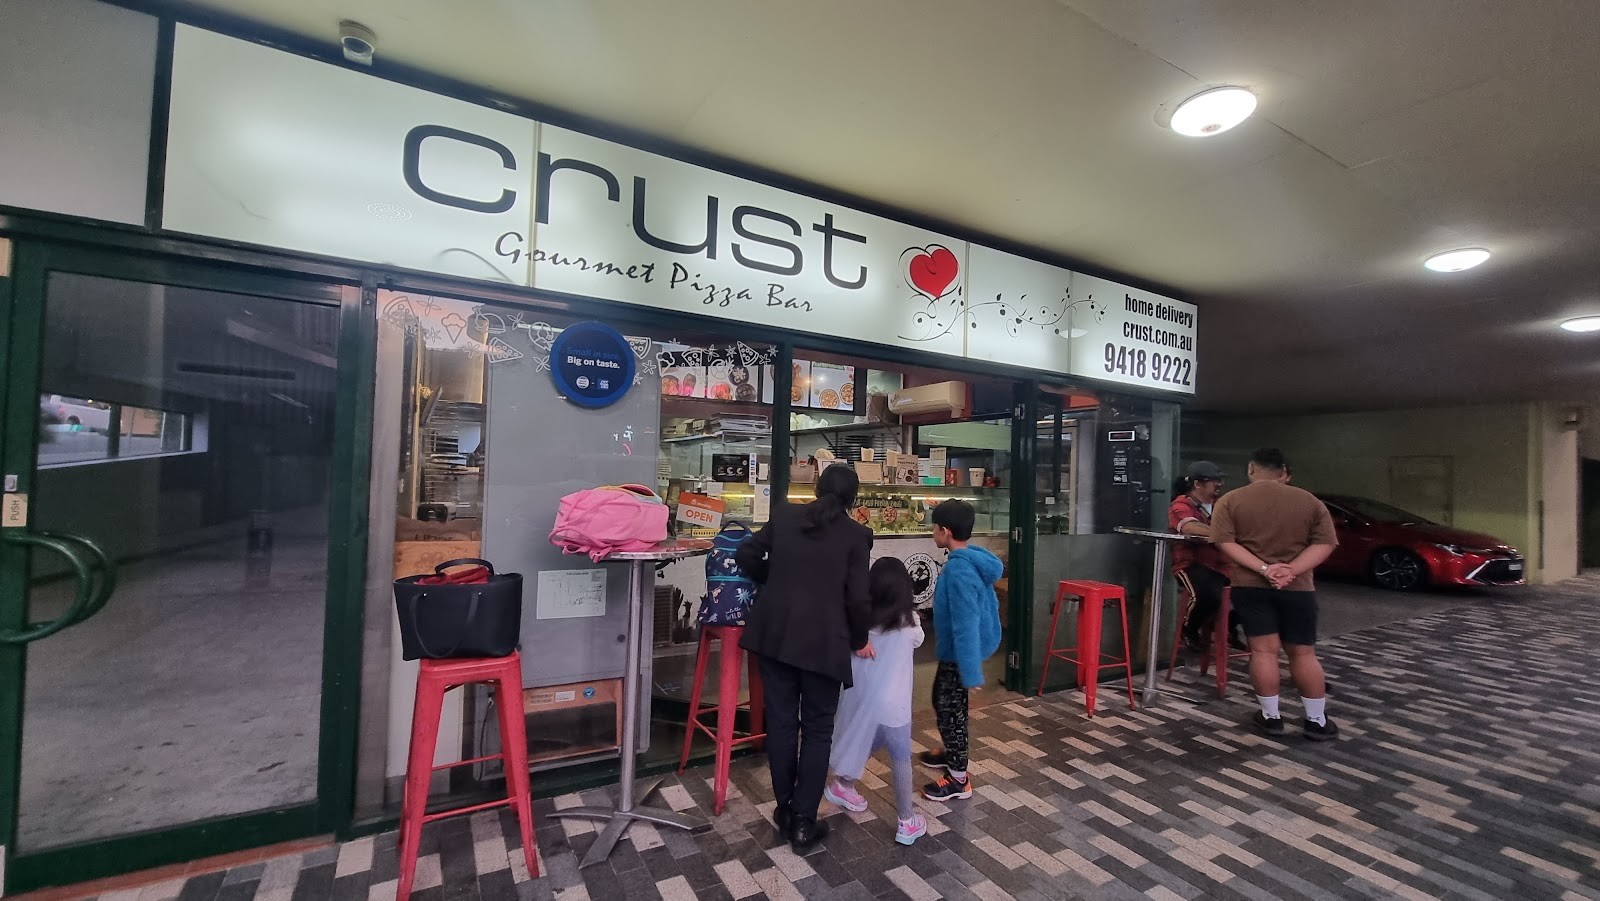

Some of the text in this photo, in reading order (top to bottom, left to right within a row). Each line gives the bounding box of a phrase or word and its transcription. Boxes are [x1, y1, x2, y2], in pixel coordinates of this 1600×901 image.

[402, 124, 868, 290] crust
[494, 231, 813, 313] Gourmet Pizza Bar
[1125, 293, 1194, 329] home delivery
[1123, 321, 1192, 352] crust.com.au
[567, 355, 621, 369] Big on taste.
[1104, 342, 1192, 387] 9418 9222
[10, 499, 20, 521] PUSH
[685, 509, 714, 523] OPEN
[725, 611, 742, 621] WILD
